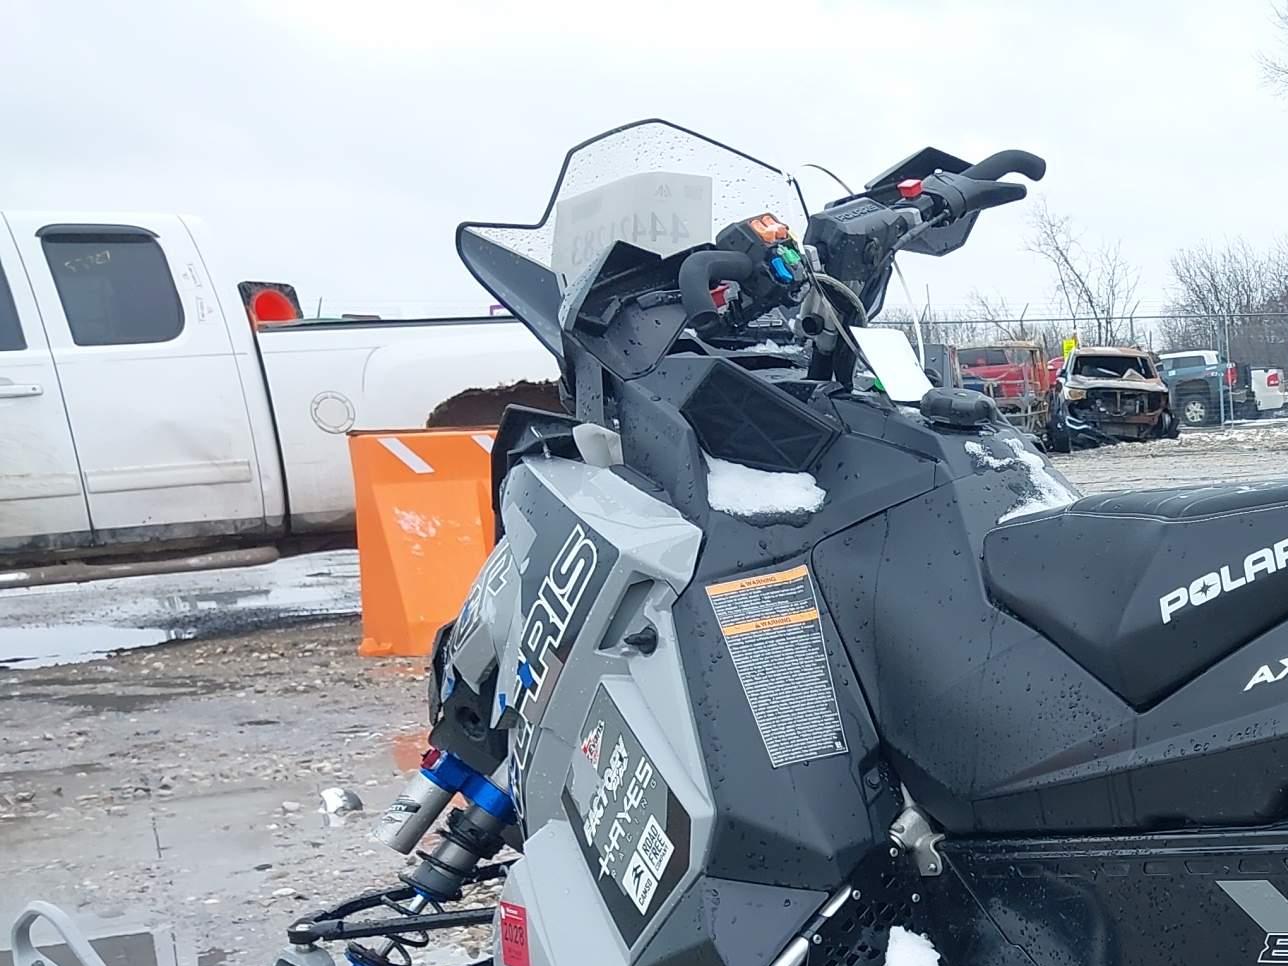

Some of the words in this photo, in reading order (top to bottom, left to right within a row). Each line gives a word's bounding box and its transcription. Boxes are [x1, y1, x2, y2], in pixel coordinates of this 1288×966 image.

[746, 577, 777, 587] WARNING
[761, 617, 792, 627] WARNING
[598, 756, 653, 880] HAYES
[642, 824, 659, 856] ROAD
[648, 834, 665, 867] FREE
[638, 878, 653, 906] CAMSO
[504, 922, 525, 946] 2028
